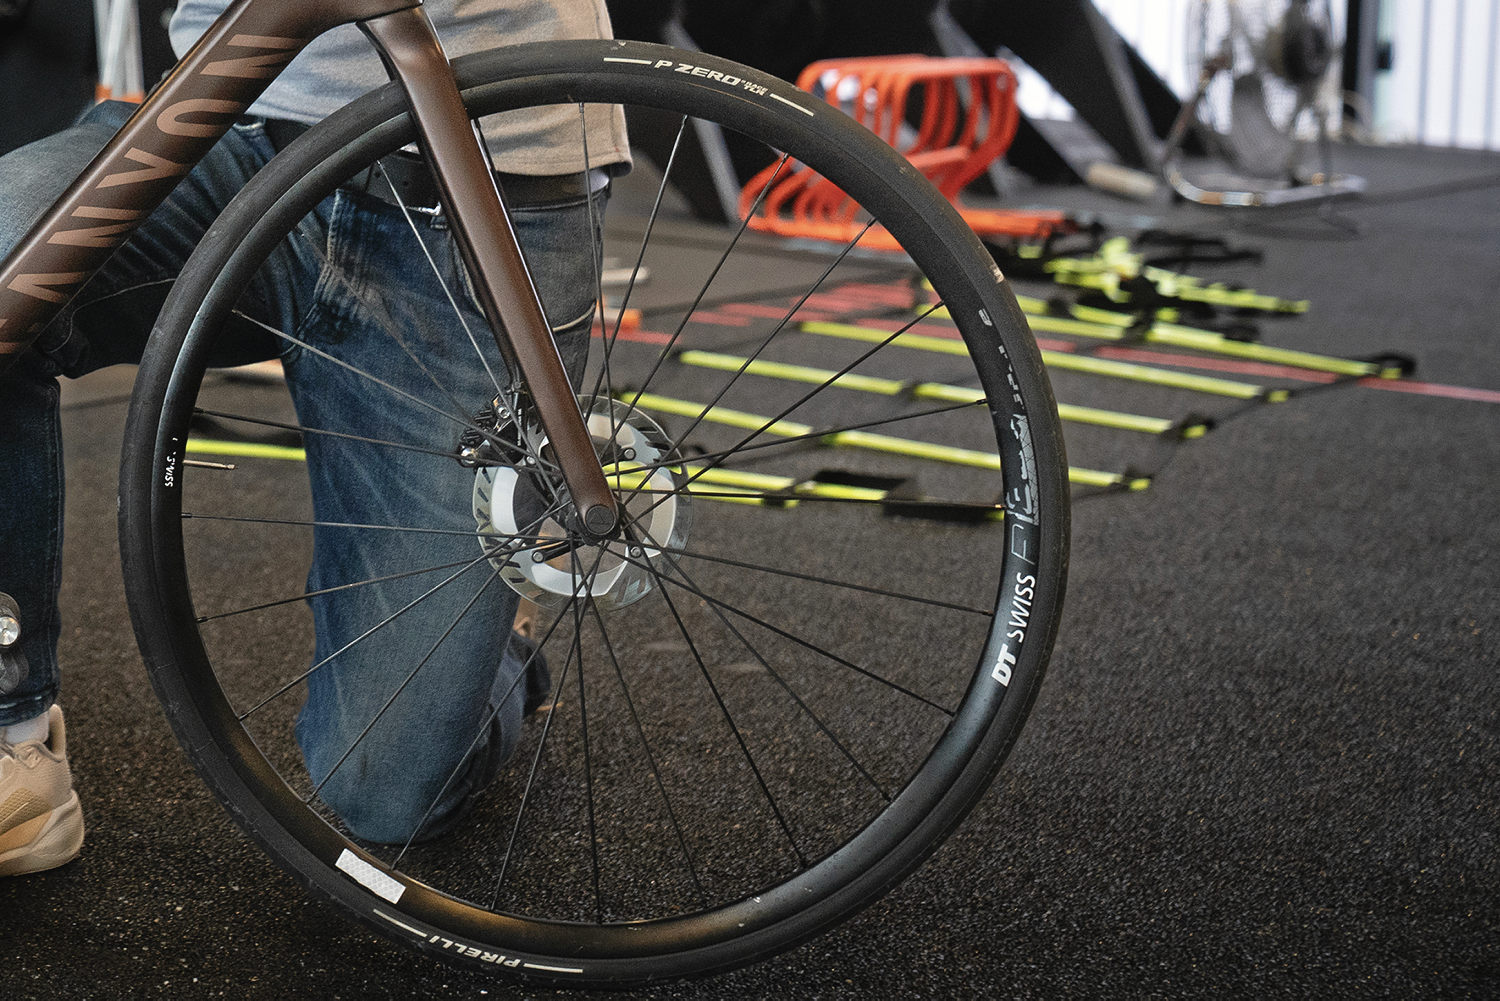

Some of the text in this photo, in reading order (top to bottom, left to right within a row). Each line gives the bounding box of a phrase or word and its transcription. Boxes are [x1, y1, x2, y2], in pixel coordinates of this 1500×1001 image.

[654, 60, 673, 69] P
[674, 63, 741, 87] ZERO
[991, 644, 1016, 686] DT
[1007, 572, 1036, 642] SWISS
[429, 935, 521, 968] PIRELLI
